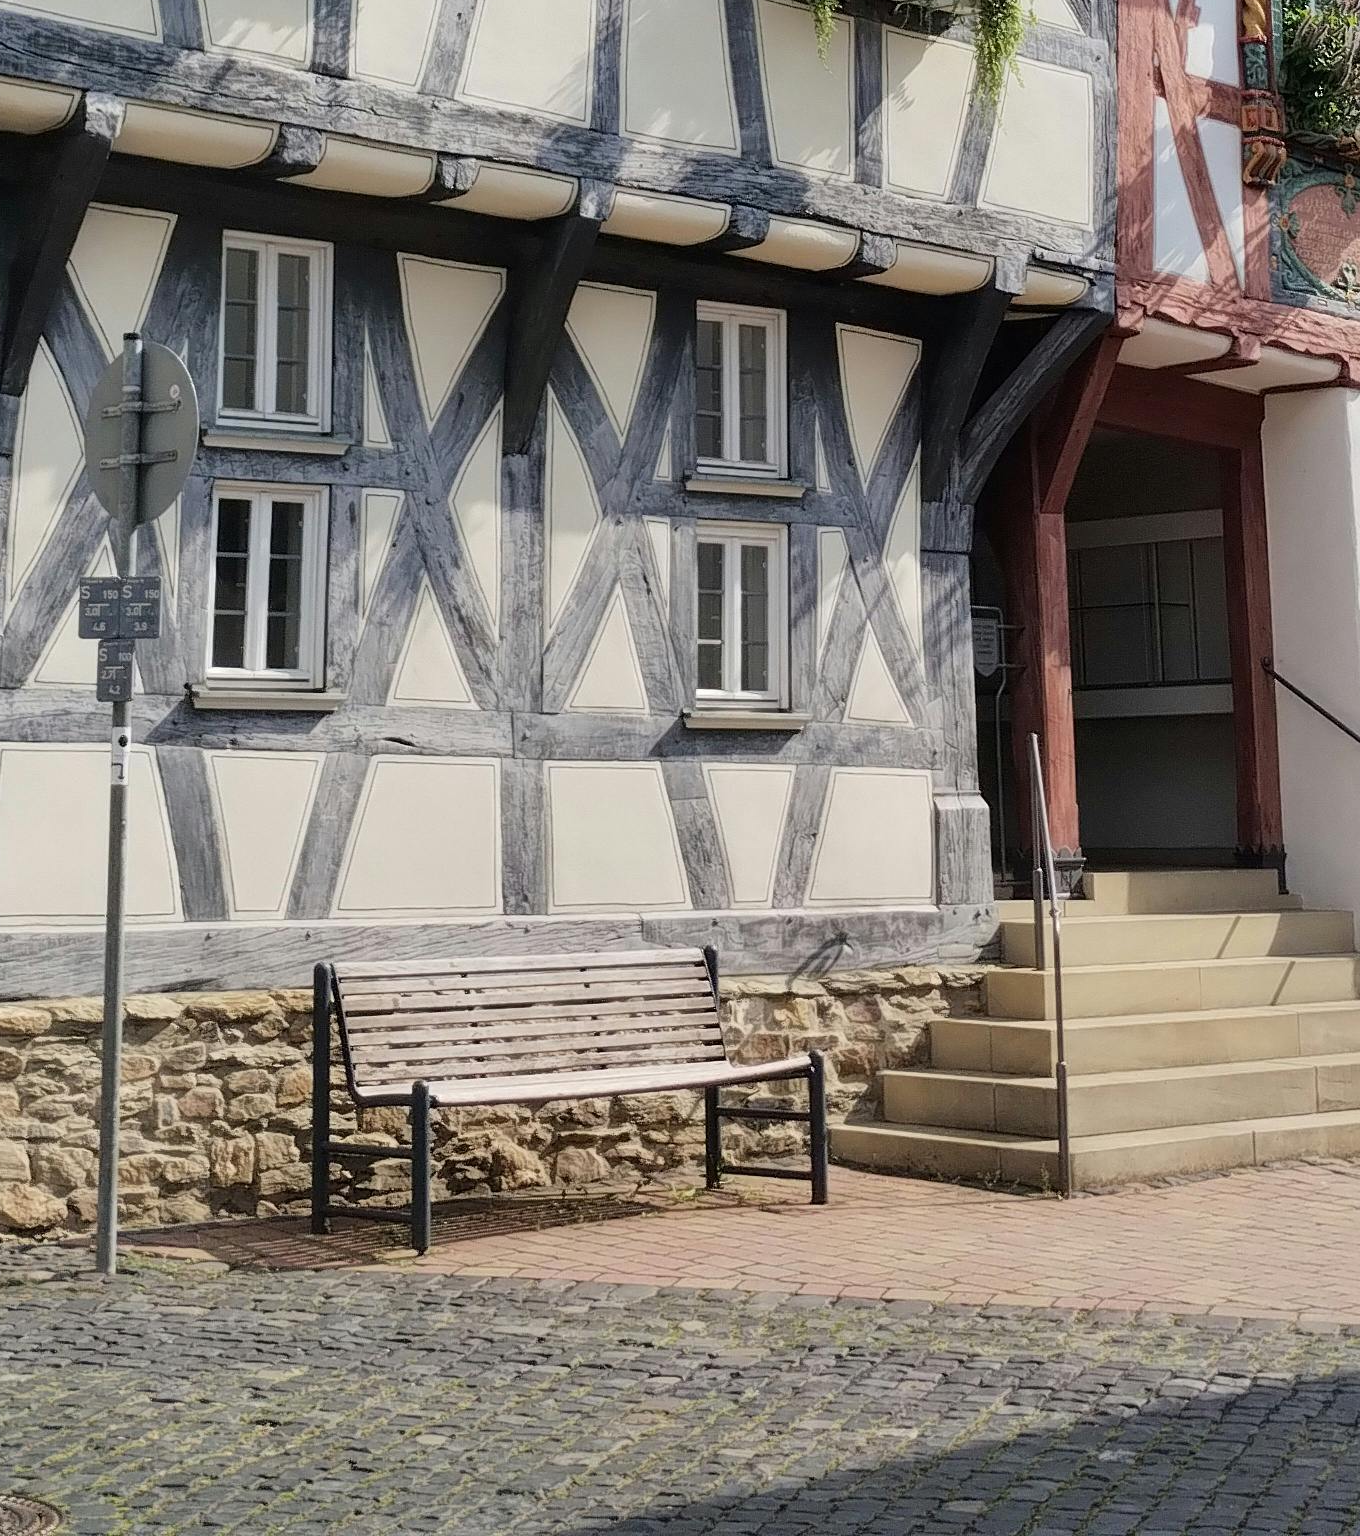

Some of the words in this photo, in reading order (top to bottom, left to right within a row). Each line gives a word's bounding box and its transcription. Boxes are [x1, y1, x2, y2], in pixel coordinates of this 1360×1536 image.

[81, 585, 91, 599] S
[103, 590, 119, 599] 150
[121, 585, 133, 599] S
[144, 589, 160, 599] 150
[99, 648, 108, 662] S
